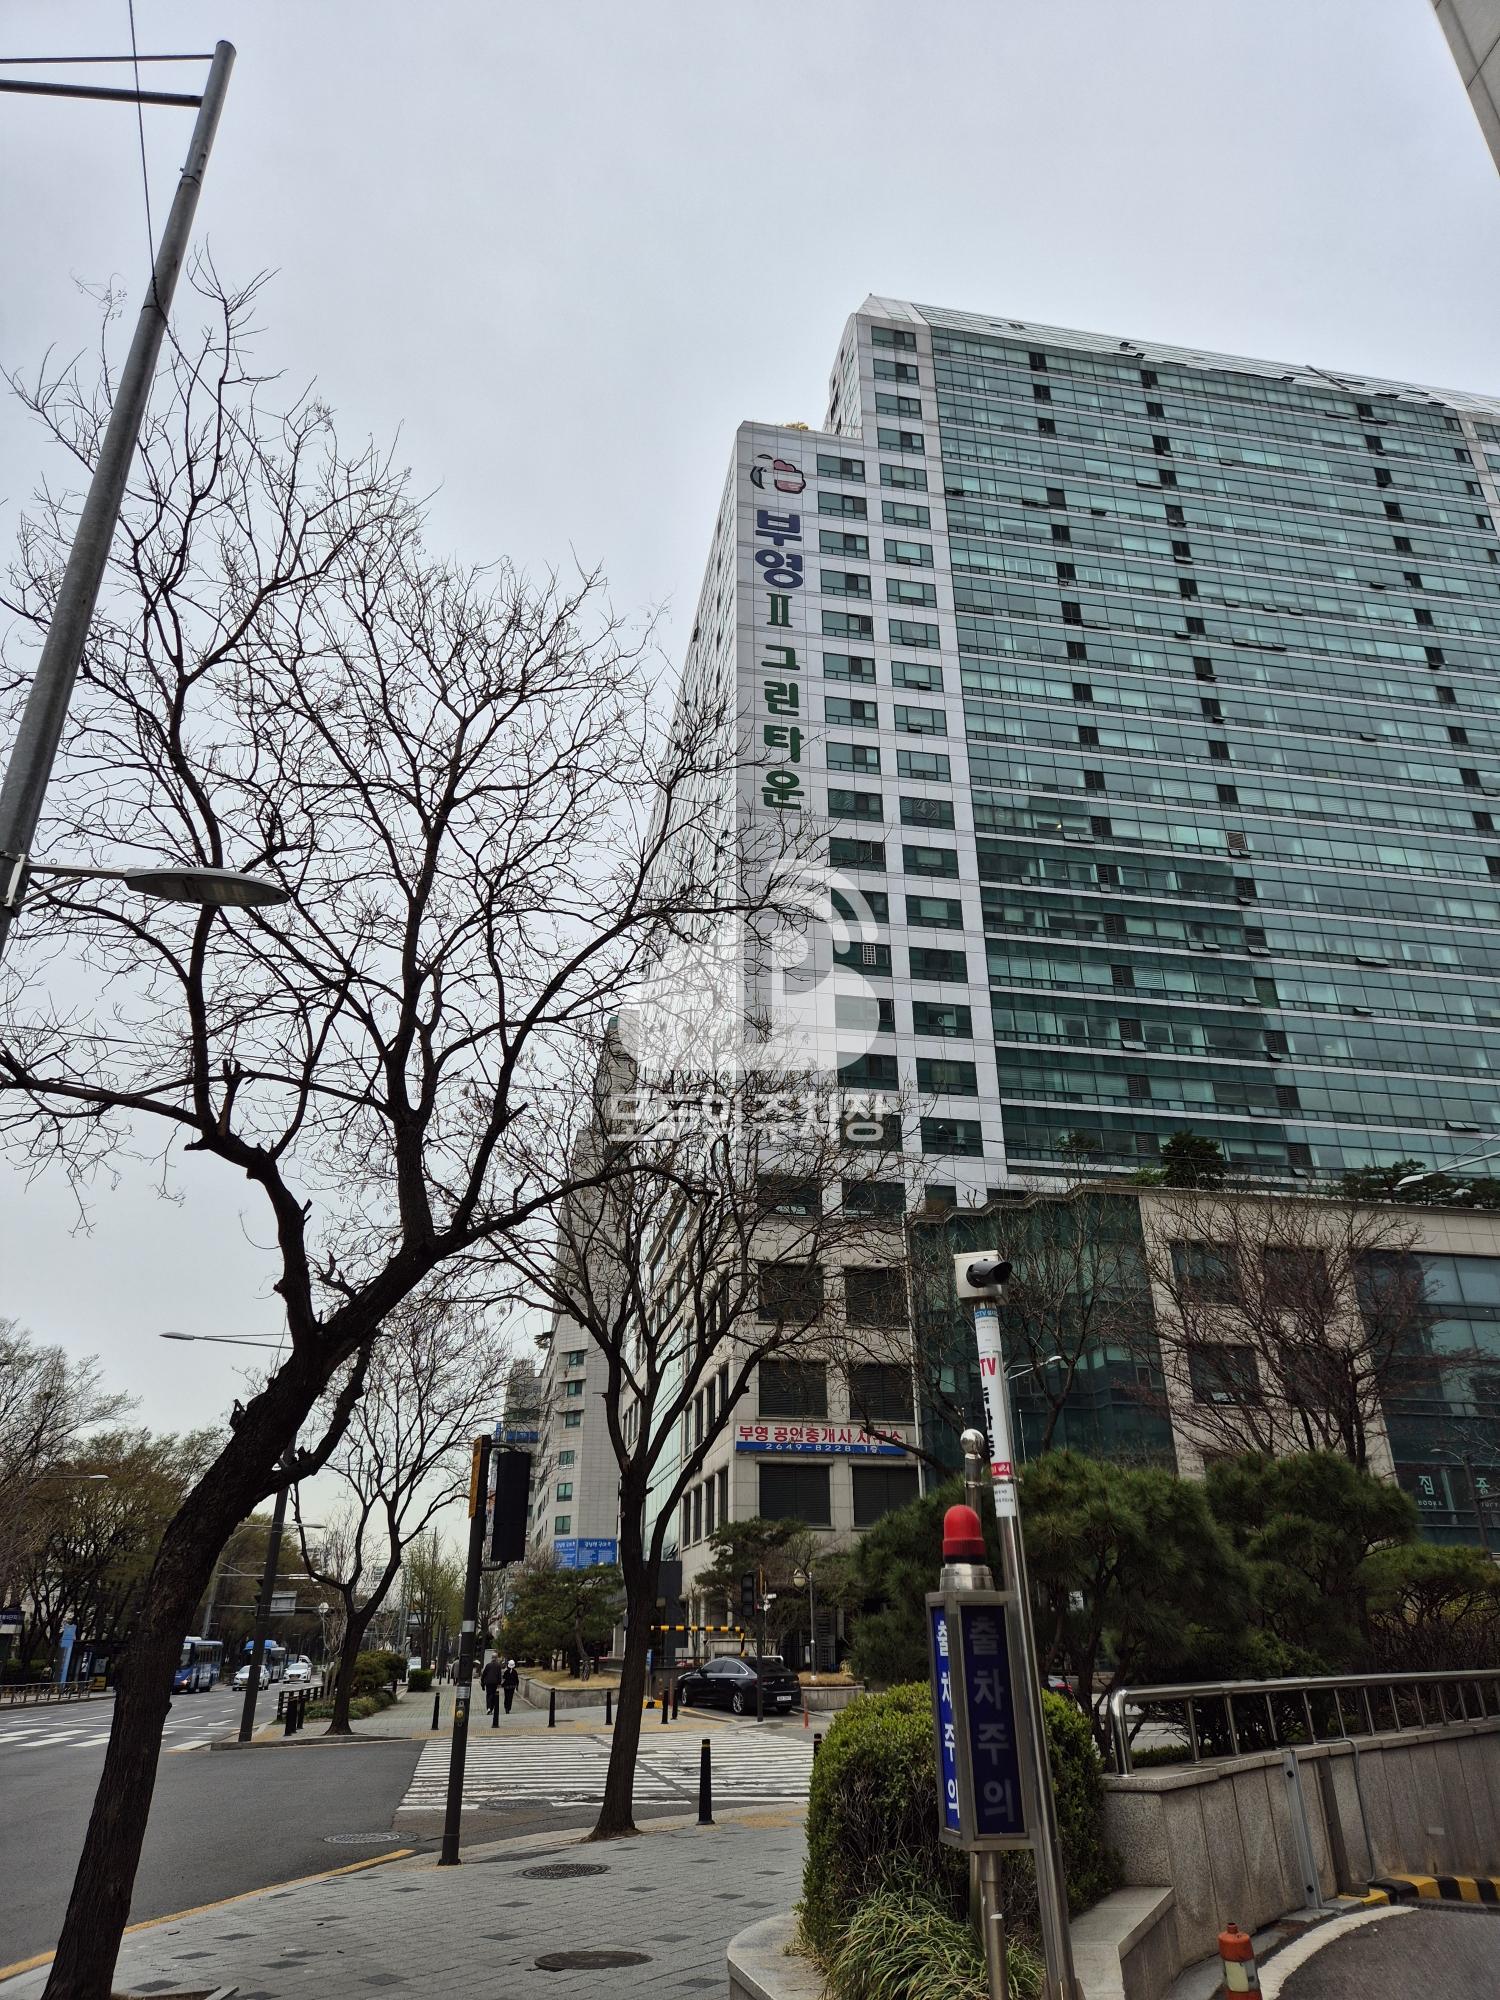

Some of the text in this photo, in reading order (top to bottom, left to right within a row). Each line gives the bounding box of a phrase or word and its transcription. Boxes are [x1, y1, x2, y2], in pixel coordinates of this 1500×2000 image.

[755, 509, 803, 588] 부영
[761, 644, 805, 810] 그린타운
[739, 1426, 769, 1442] 부영
[774, 1427, 853, 1444] 공인중개사
[765, 1443, 851, 1453] 2649-8228
[936, 1620, 961, 1819] 출차주의
[969, 1616, 1015, 1823] 출차주의
